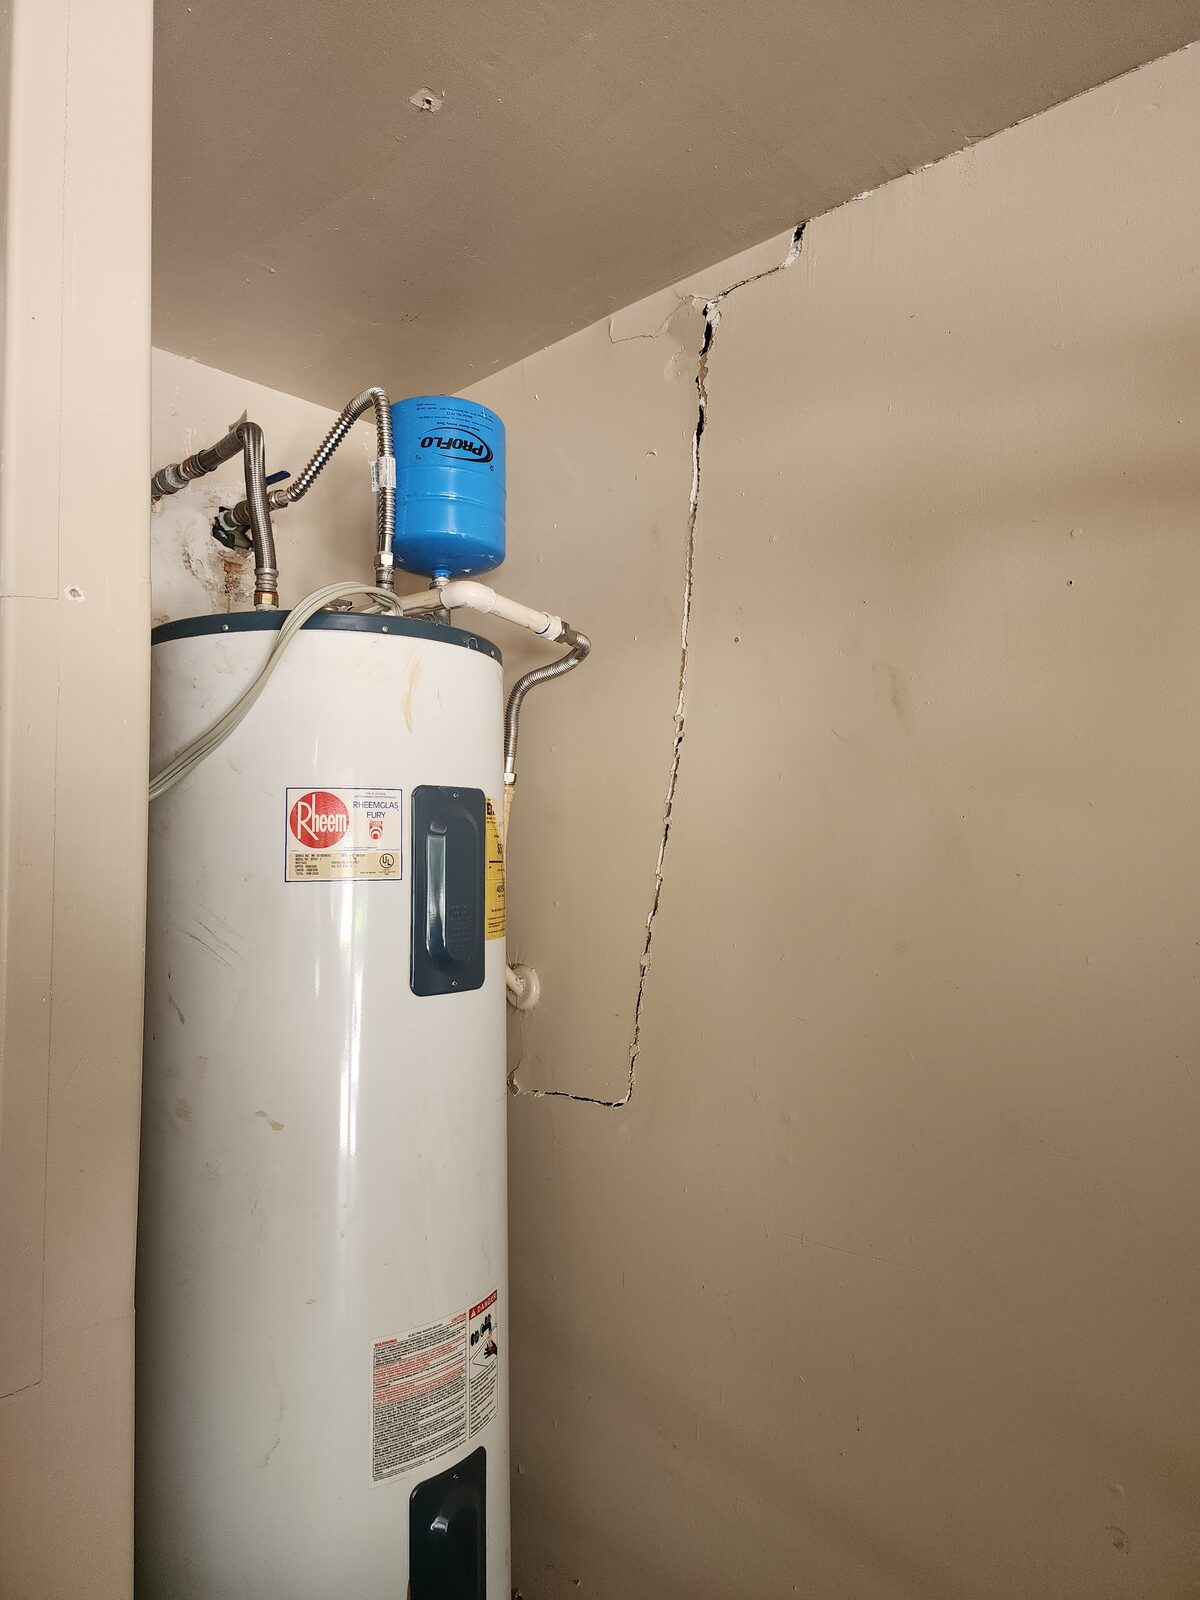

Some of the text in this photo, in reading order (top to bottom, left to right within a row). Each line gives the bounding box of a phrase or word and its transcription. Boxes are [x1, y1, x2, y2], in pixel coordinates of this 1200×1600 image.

[420, 436, 484, 457] PROFLO
[353, 801, 399, 809] RHEEMGLAS
[297, 793, 347, 841] Rheem
[366, 811, 386, 819] FURY
[374, 1338, 398, 1348] WARNING
